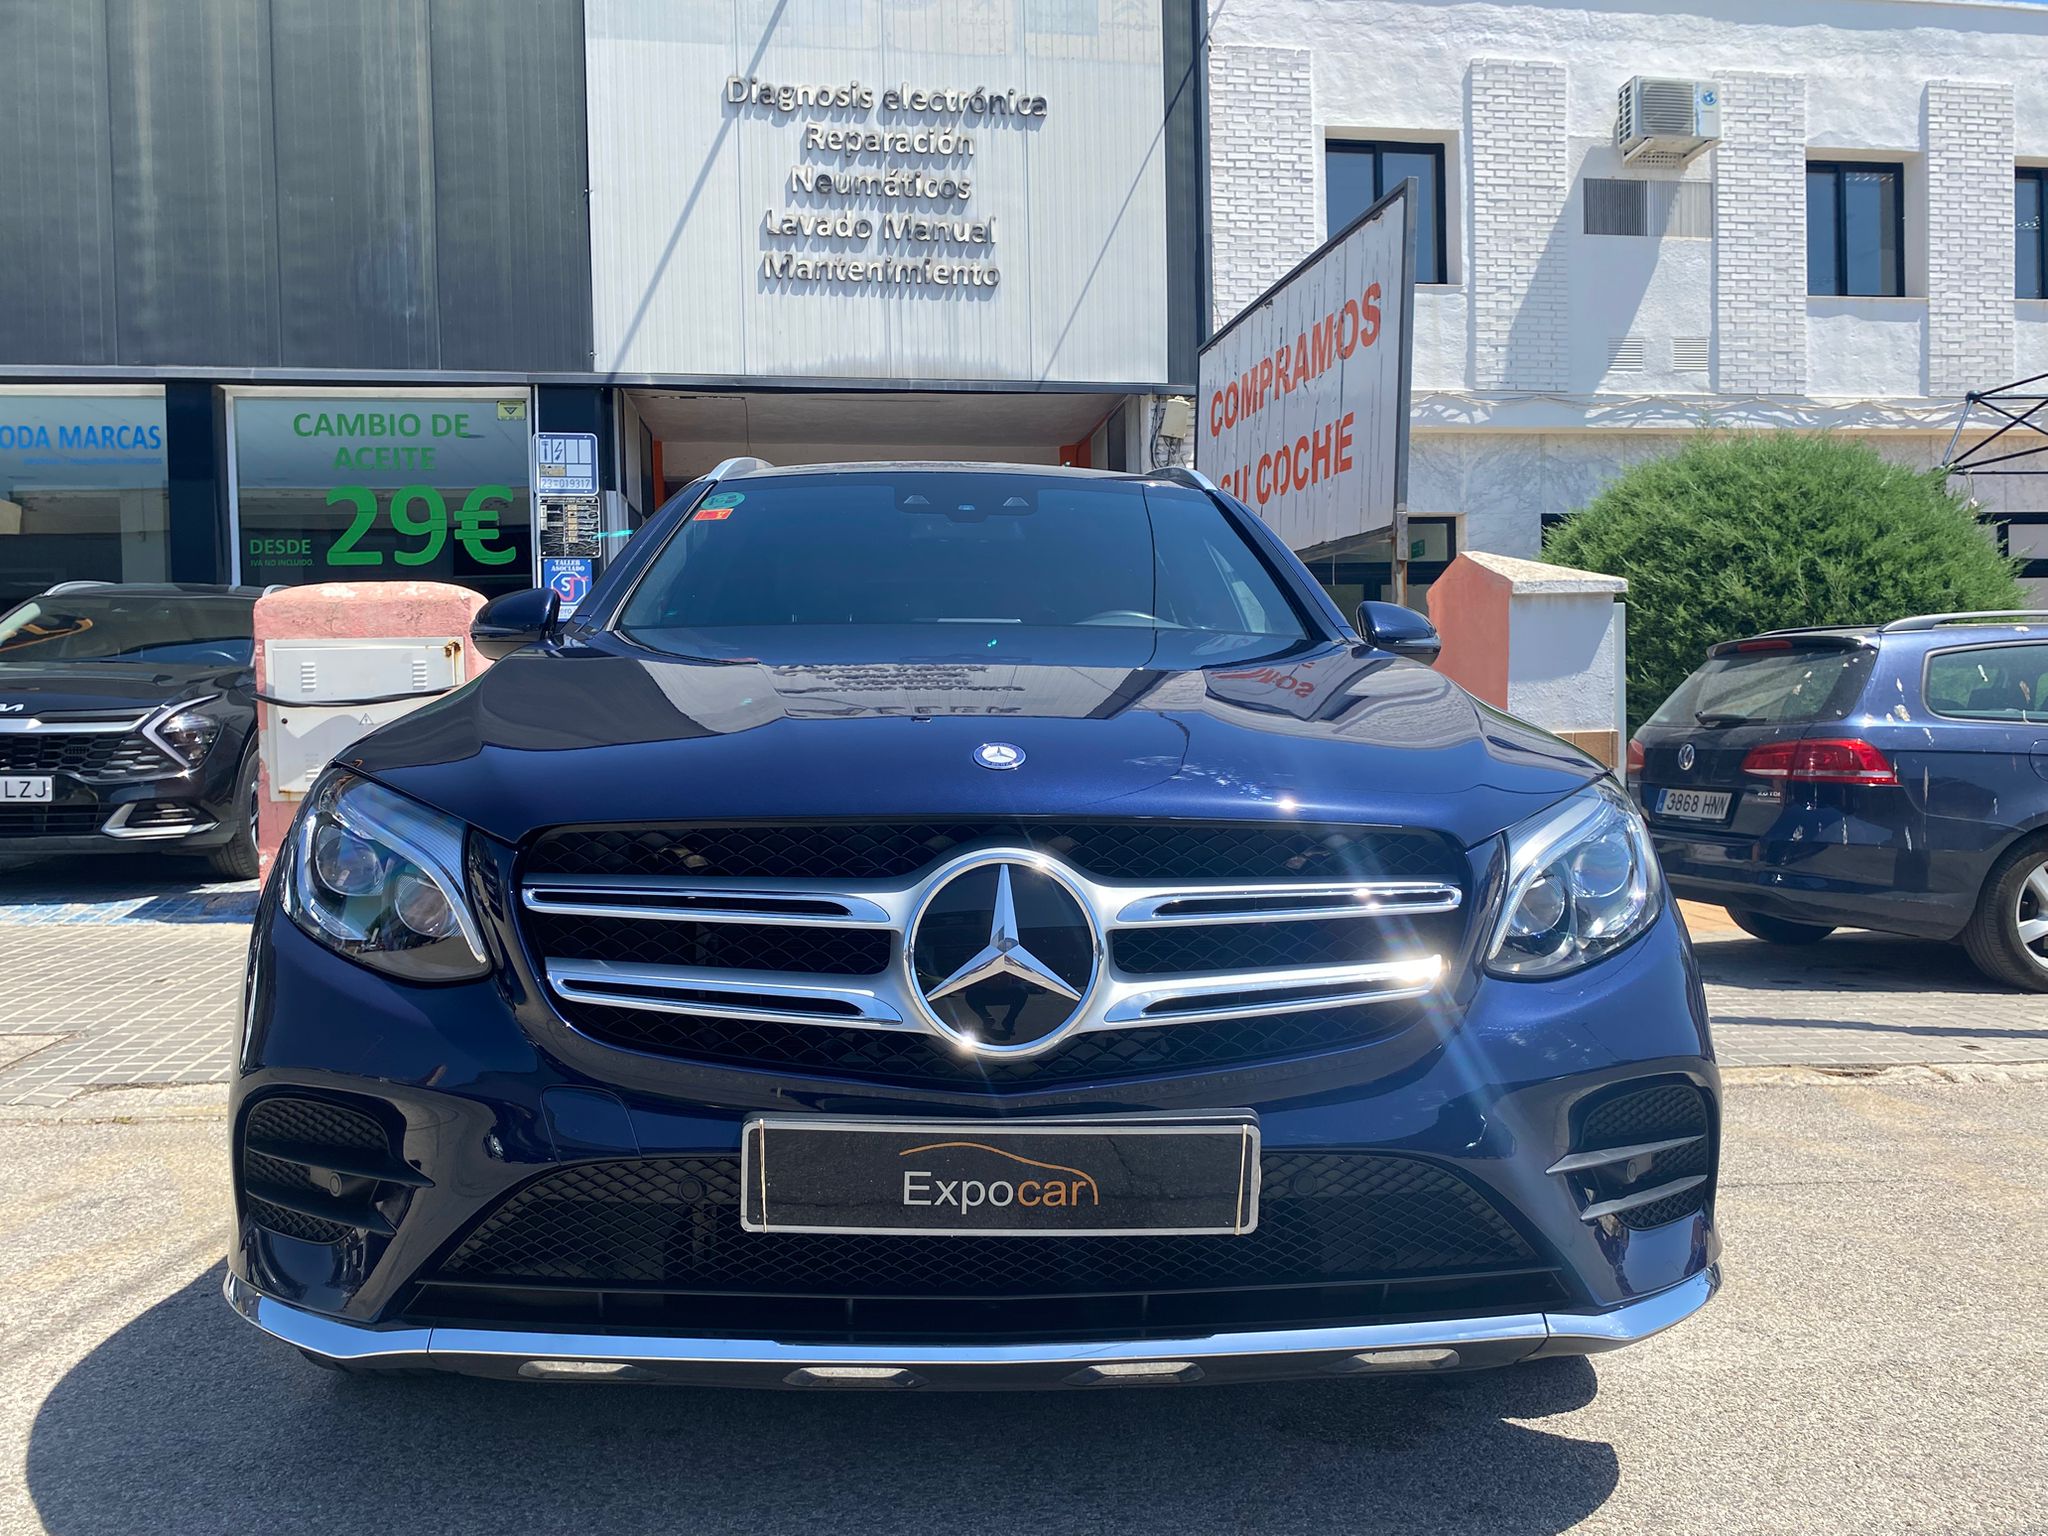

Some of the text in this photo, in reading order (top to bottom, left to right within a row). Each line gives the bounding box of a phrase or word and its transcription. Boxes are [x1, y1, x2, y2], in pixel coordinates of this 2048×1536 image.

[726, 75, 1048, 117] Diagnosis electrónica
[806, 122, 975, 156] Reparación
[790, 166, 972, 200] Neumáticos
[765, 209, 998, 244] Lavado Manual
[763, 253, 1001, 287] Mantenimiento
[1210, 281, 1382, 438] COMPRAMOS
[58, 425, 162, 450] MARCAS
[293, 413, 471, 438] CAMBIO DE
[332, 446, 438, 471] ACEITE
[1255, 412, 1355, 506] COCHE
[325, 484, 518, 567] 29€
[249, 539, 312, 555] DESDE
[4, 780, 47, 799] LZJ
[1666, 793, 1730, 816] 3868 HNN
[903, 1170, 1087, 1215] Expocar
